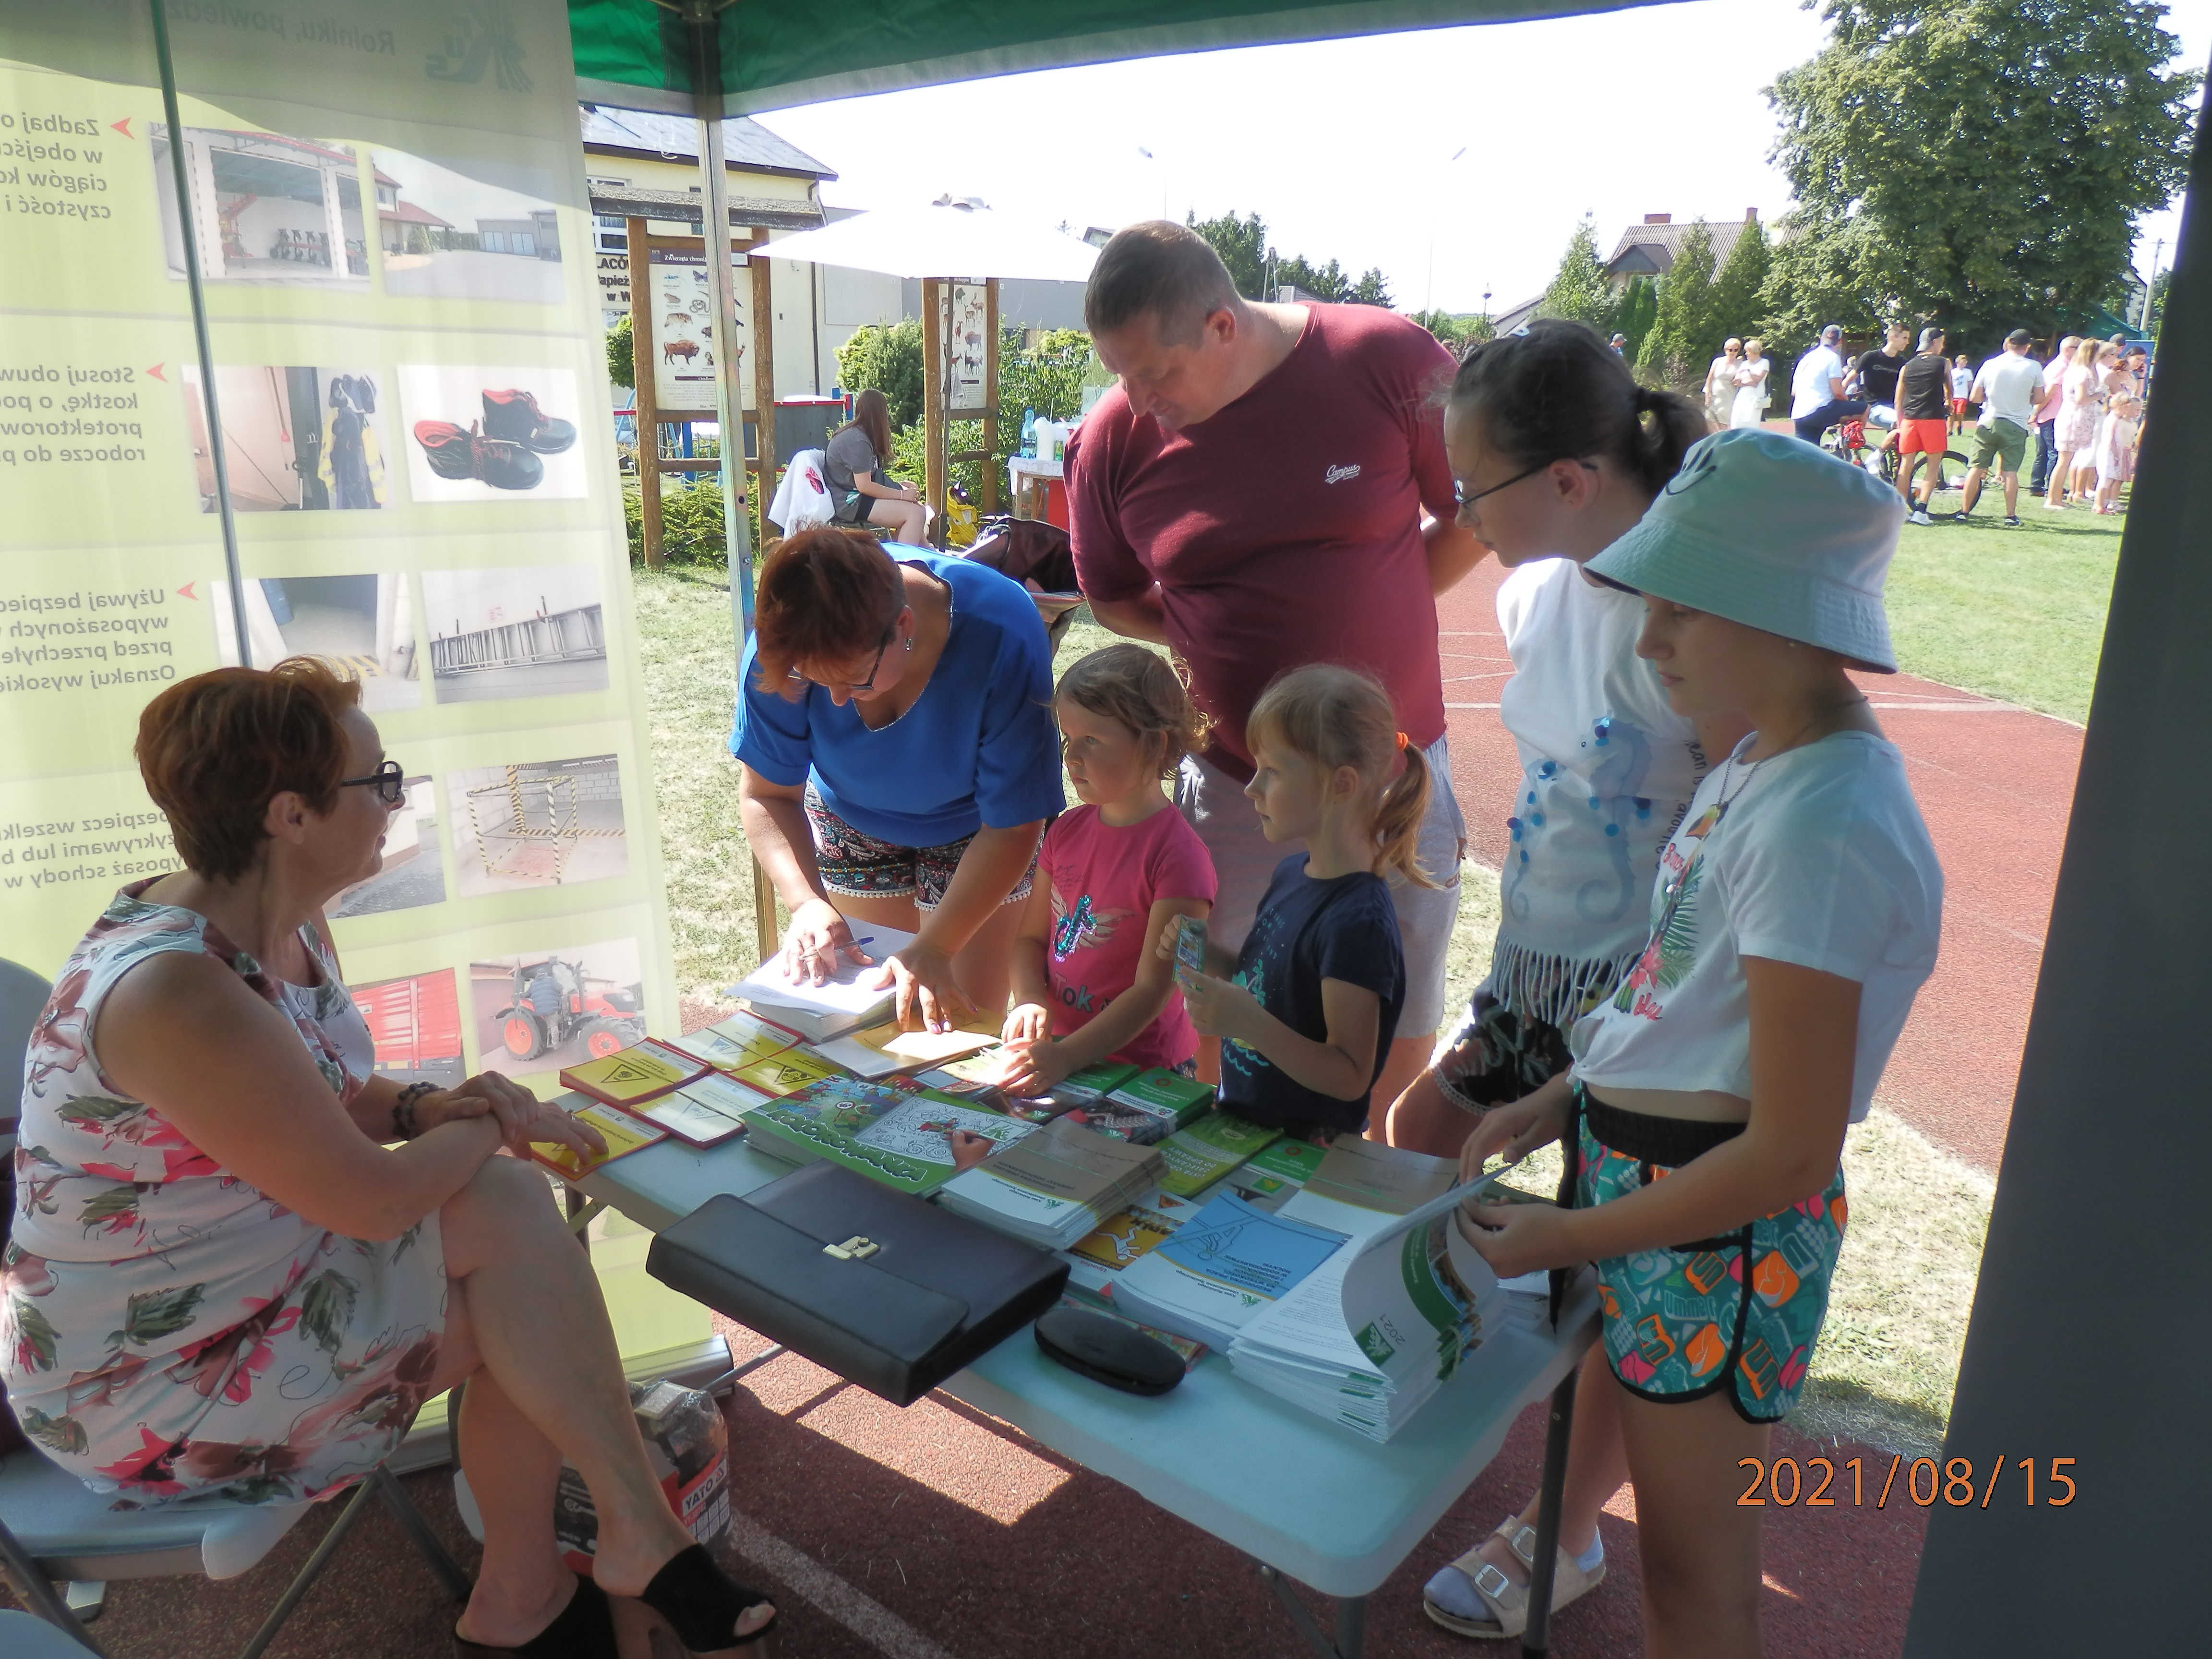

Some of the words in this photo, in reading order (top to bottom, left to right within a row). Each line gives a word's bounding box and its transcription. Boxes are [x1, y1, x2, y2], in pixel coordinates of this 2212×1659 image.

[1327, 464, 1360, 477] Campus
[1054, 971, 1095, 1012] Tok
[766, 1108, 927, 1182] KOLOROWANKA
[1379, 1313, 1406, 1345] 2021
[685, 1479, 713, 1510] YATO
